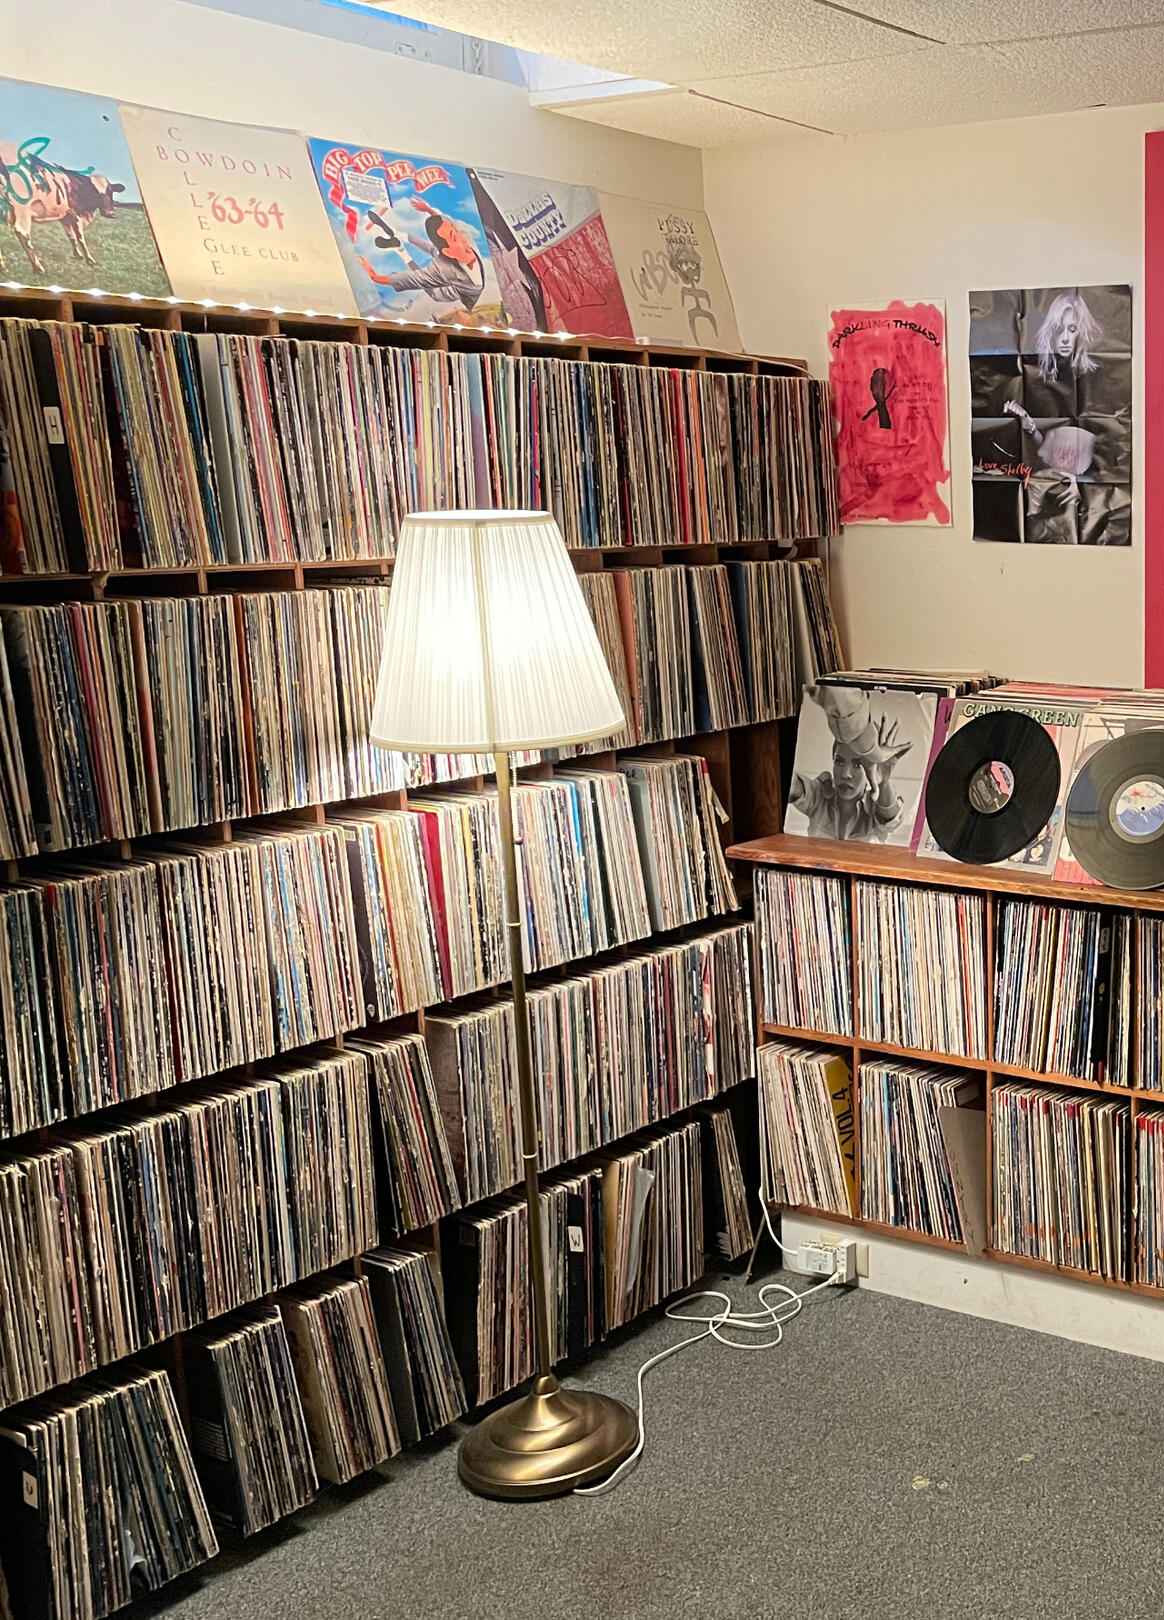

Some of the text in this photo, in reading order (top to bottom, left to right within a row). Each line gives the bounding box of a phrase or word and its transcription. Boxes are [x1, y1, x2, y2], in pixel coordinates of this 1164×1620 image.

[156, 145, 293, 180] BOWDOIN
[324, 151, 444, 188] BIG TOP PEE WEE
[520, 211, 567, 251] COUNTY
[203, 238, 300, 263] GLEE CLUB
[832, 319, 941, 349] DARKLING THRUSH
